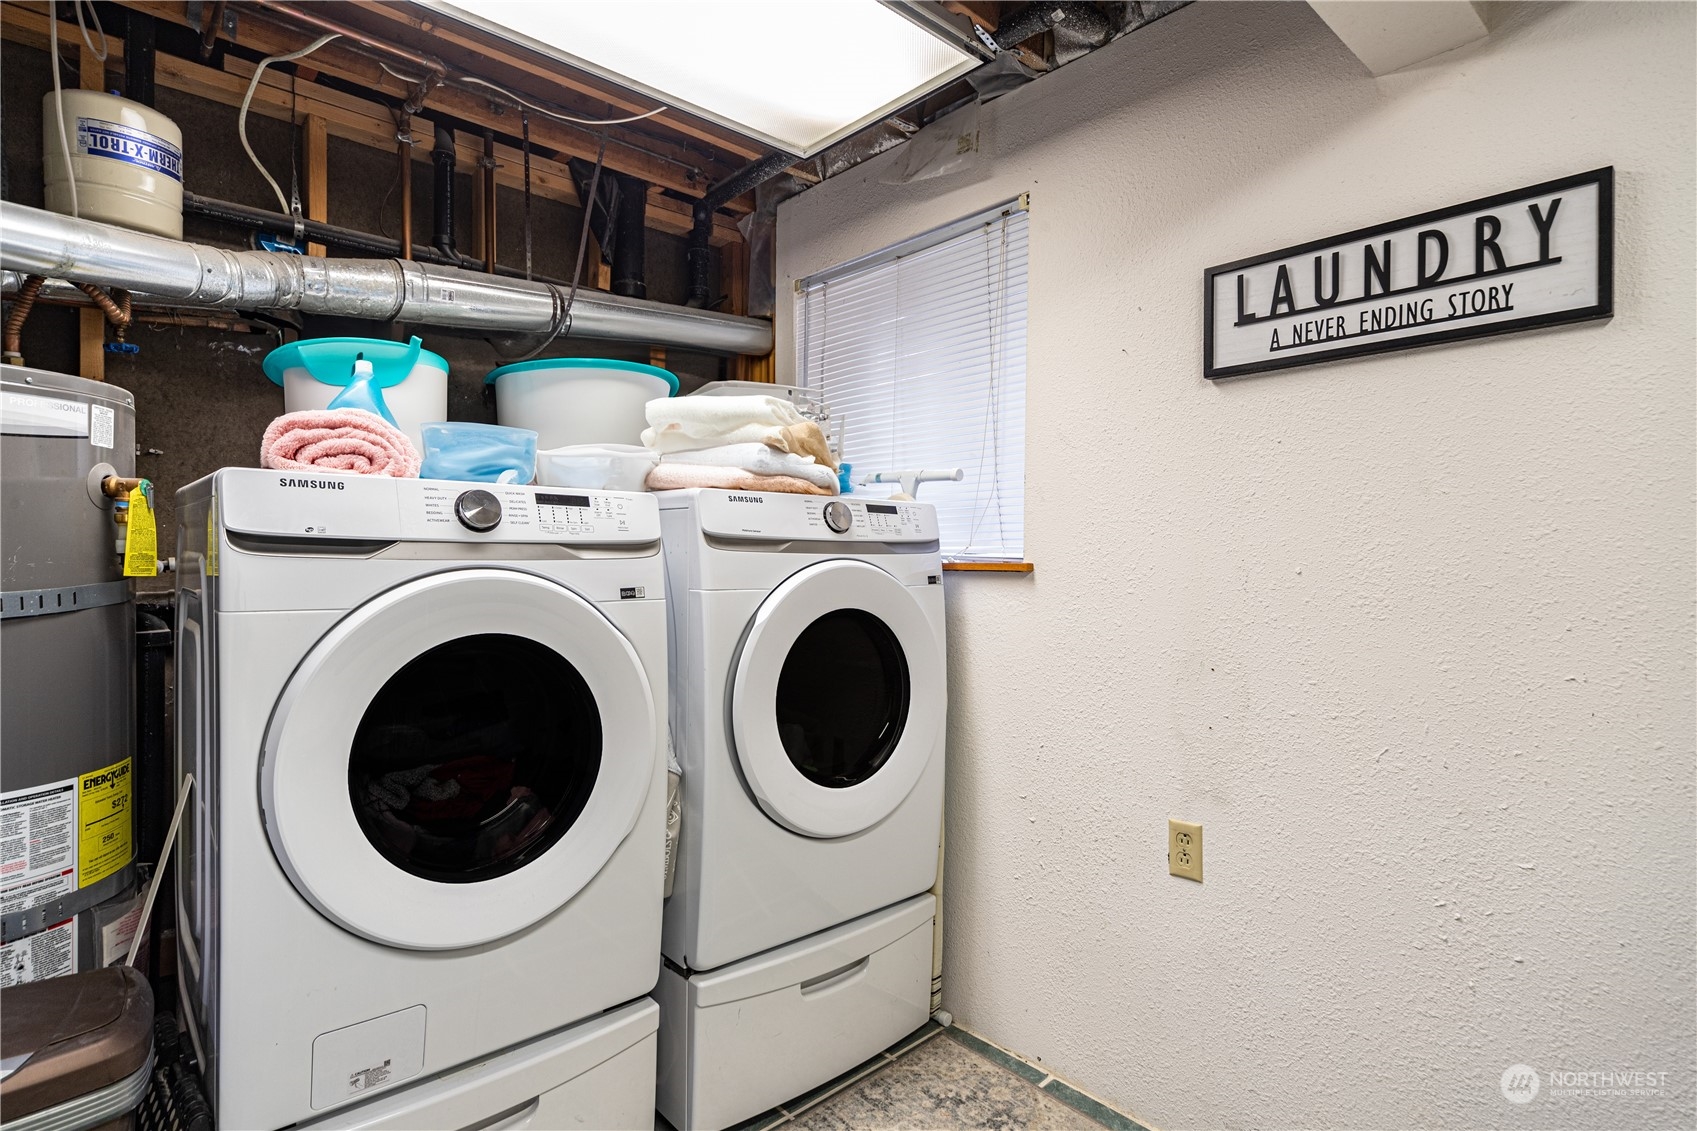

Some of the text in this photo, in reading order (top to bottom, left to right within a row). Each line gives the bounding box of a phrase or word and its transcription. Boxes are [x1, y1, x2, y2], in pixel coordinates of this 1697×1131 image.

[88, 133, 180, 174] THERM-X-TROL
[1234, 197, 1562, 326] LAUNDRY
[1270, 282, 1515, 351] A NEVER ENDING STORY
[279, 477, 345, 490] SAMSUNG
[728, 495, 764, 504] SAMSUNG
[84, 763, 130, 790] ENERGYGUIDE
